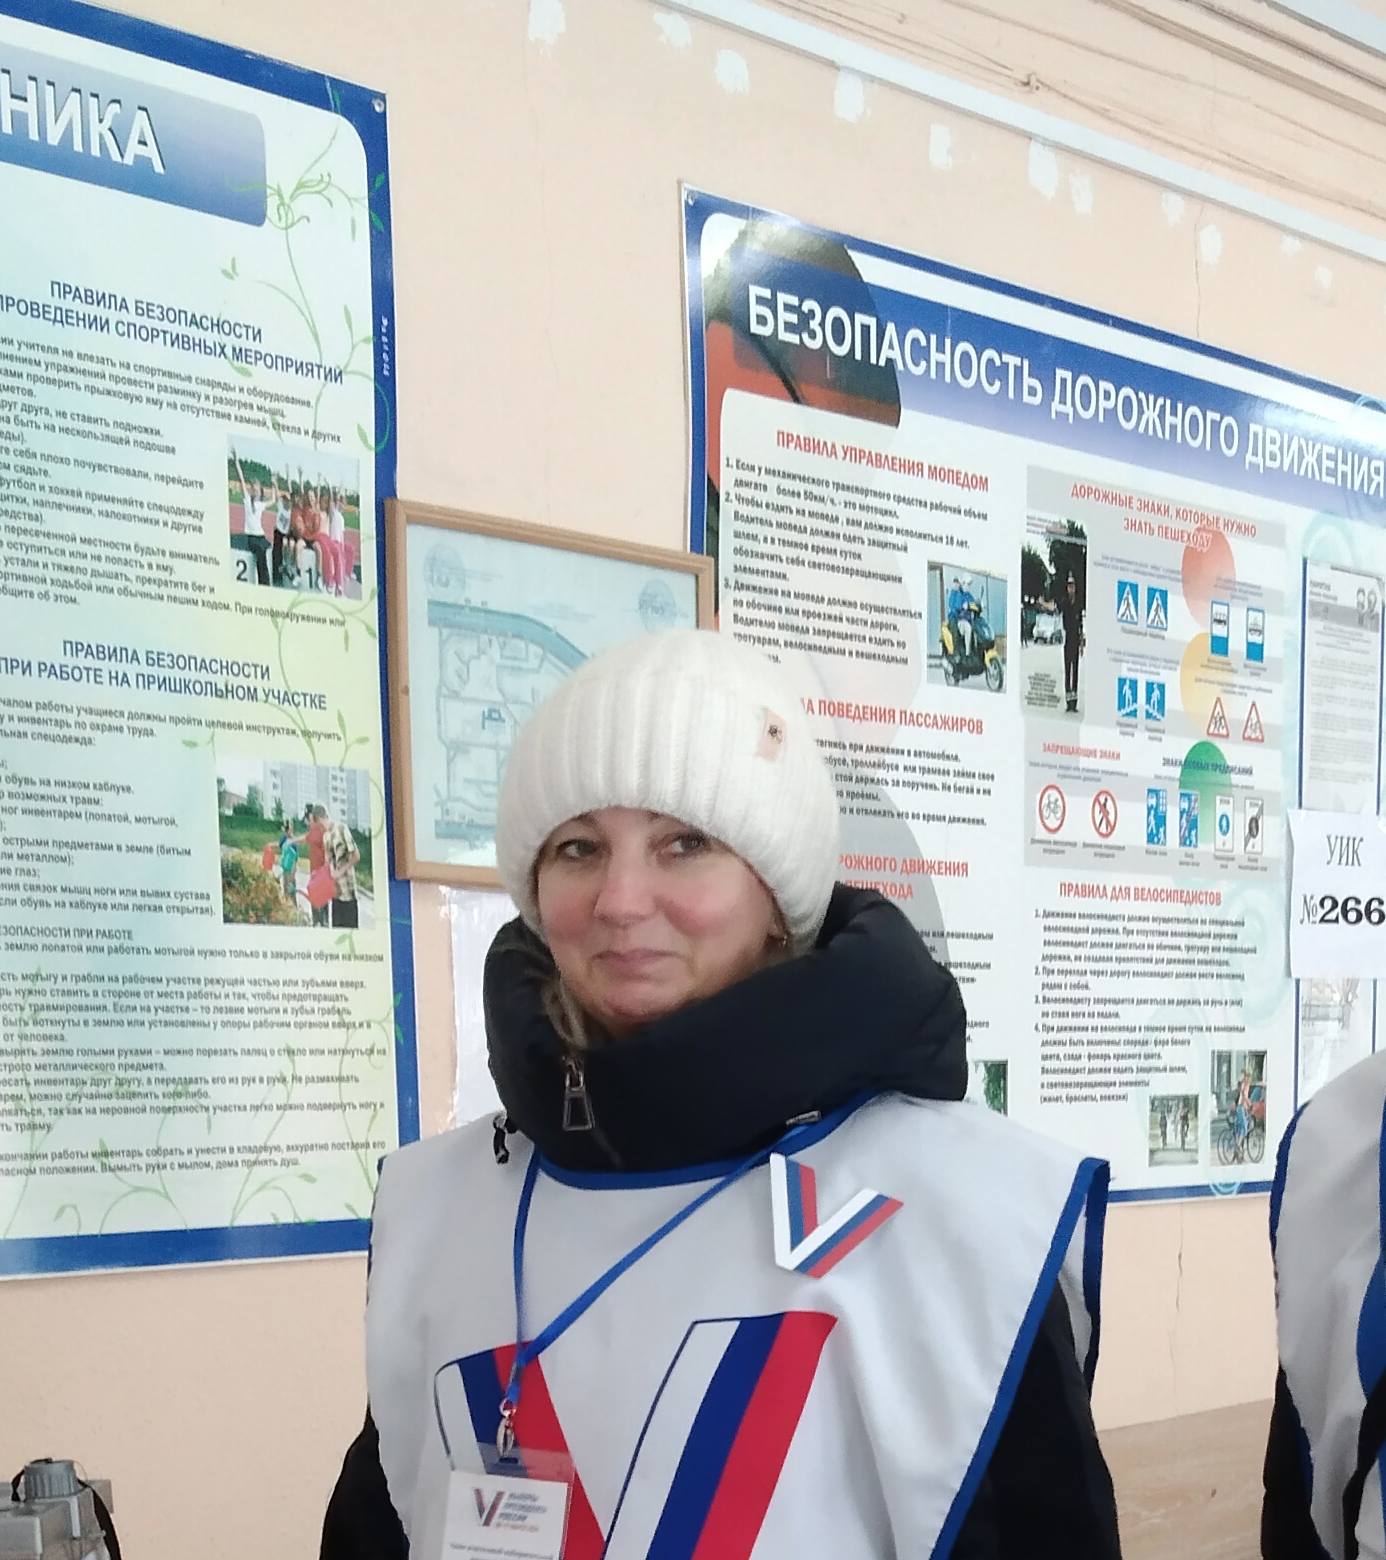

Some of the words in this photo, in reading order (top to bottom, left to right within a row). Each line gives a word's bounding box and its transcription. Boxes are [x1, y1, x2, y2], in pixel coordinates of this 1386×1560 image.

[50, 280, 130, 313] ПРАВИЛА
[134, 299, 262, 343] БЕЗОПАСНОСТИ
[114, 320, 228, 359] СПОРТИВНЫХ
[230, 345, 344, 384] МЕРОПРИЯТИЙ
[747, 283, 1043, 406] БЕЗОПАСНОСТЬ
[1051, 371, 1239, 457] ДОРОЖНОГО
[1245, 428, 1386, 499] ДВИЖЕНИЯ
[19, 402, 53, 418] друга,
[54, 409, 68, 420] не
[69, 411, 111, 428] ставить
[112, 419, 164, 437] подножки.
[776, 430, 838, 459] ПРАВИЛА
[840, 445, 924, 477] УПРАВЛЕНИЯ
[927, 464, 989, 492] МОПЕДОМ
[38, 483, 46, 493] и
[47, 485, 83, 499] хоккей
[84, 490, 145, 509] применяйте
[146, 501, 205, 521] спецодежду
[1070, 483, 1134, 510] ДОРОЖНЫЕ
[1136, 497, 1173, 520] ЗНАКИ,
[1174, 507, 1221, 532] КОТОРЫЕ
[1222, 517, 1257, 538] НУЖНО
[1123, 517, 1155, 536] ЗНАТЬ
[1156, 524, 1216, 550] ПЕШЕХОДУ
[236, 560, 248, 582] 2
[62, 639, 141, 665] ПРАВИЛА
[144, 649, 270, 680] БЕЗОПАСНОСТИ
[37, 661, 104, 685] РАБОТЕ
[107, 669, 131, 688] НА
[134, 672, 259, 702] ПРИШКОЛЬНОМ
[261, 686, 327, 710] УЧАСТКЕ
[818, 699, 896, 724] ПОВЕДЕНИЯ
[898, 709, 984, 735] ПАССАЖИРОВ
[30, 731, 96, 747] спецодежда:
[4, 772, 37, 788] обувь
[38, 777, 52, 788] на
[53, 779, 91, 791] низком
[92, 781, 134, 796] каблуке.
[899, 858, 969, 877] ДВИЖЕНИЯ
[1326, 834, 1364, 867] УИК
[1059, 881, 1108, 899] ПРАВИЛА
[1109, 884, 1131, 902] ДЛЯ
[1132, 886, 1222, 906] ВЕЛОСИПЕДИСТОВ
[1300, 893, 1386, 926] №266
[72, 927, 94, 939] ПРИ
[94, 928, 134, 941] РАБОТЕ
